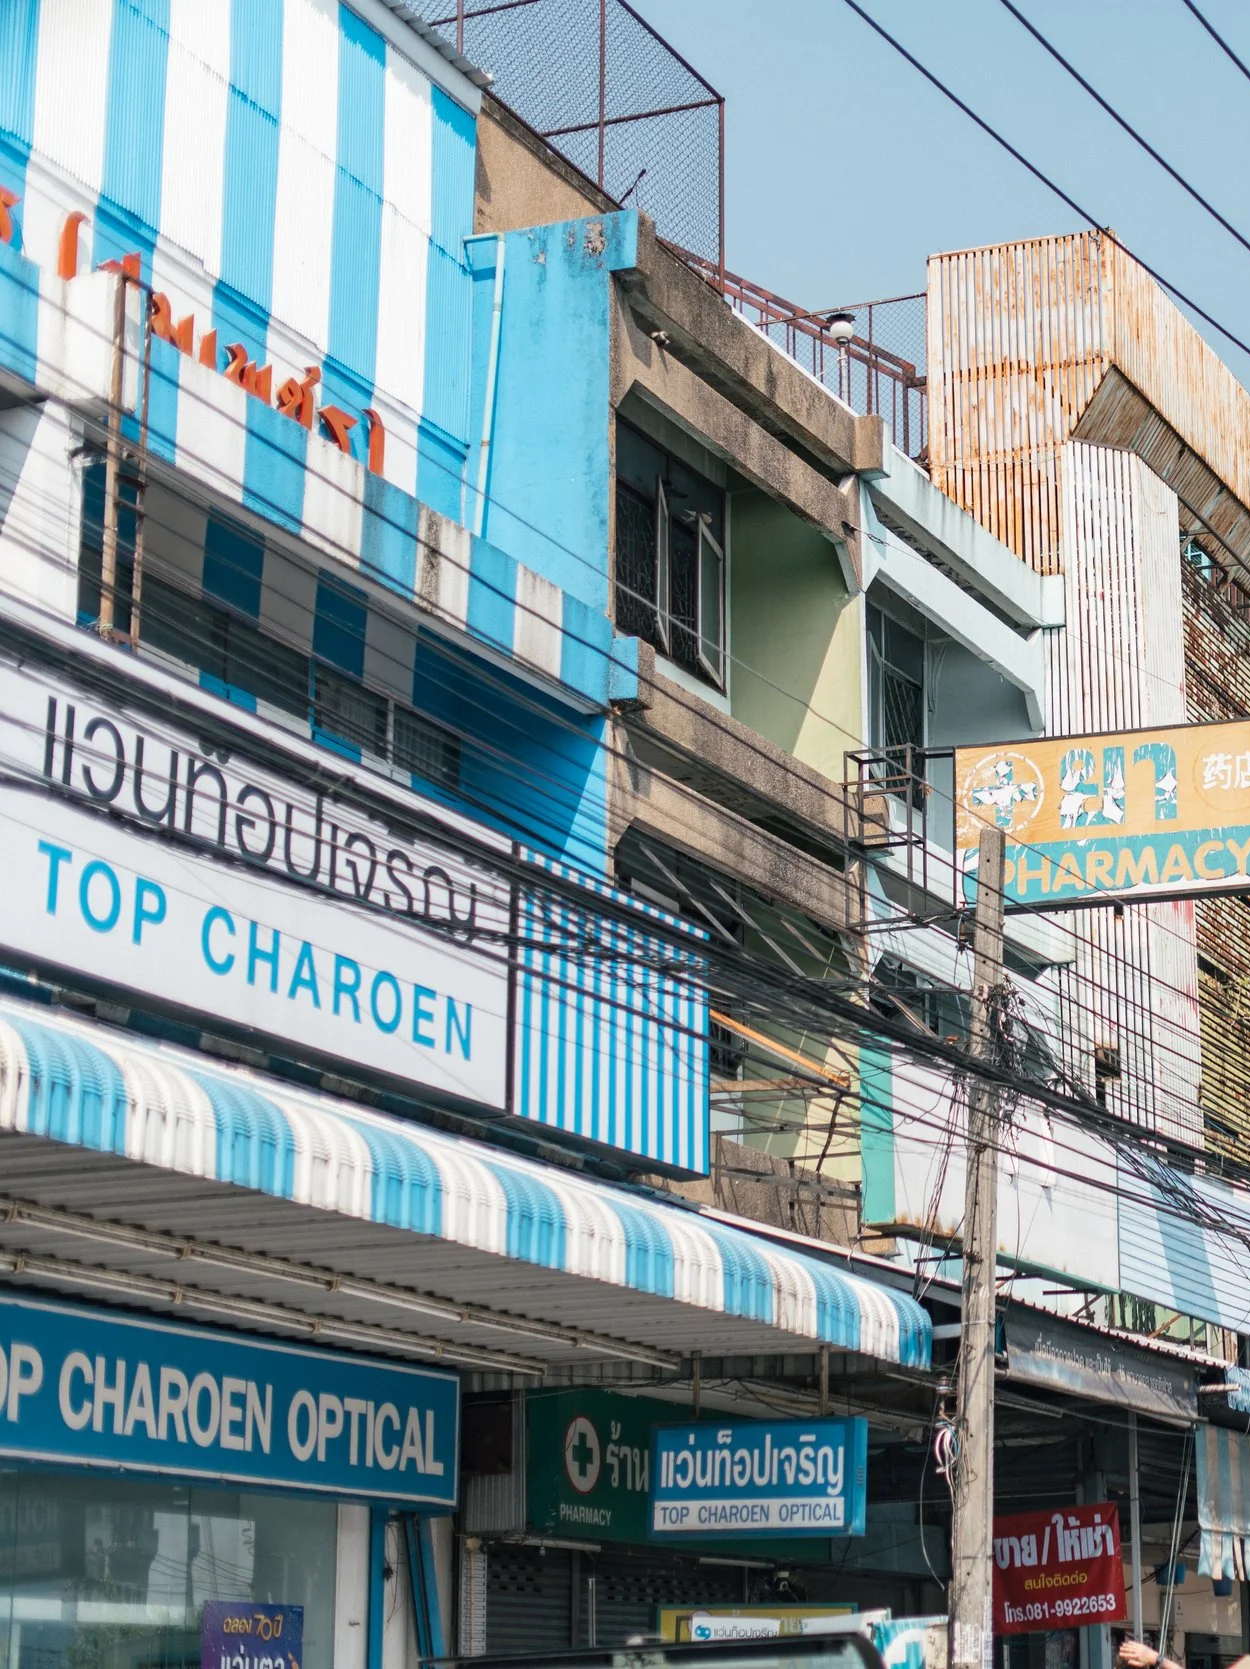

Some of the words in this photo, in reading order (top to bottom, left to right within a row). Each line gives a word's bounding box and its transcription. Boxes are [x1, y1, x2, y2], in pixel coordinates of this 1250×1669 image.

[1060, 742, 1178, 828] ยา
[37, 839, 168, 945] TOP
[201, 906, 472, 1062] CHAROEN
[0, 1343, 43, 1422] P
[59, 1351, 273, 1455] CHAROEN
[287, 1390, 444, 1477] OPTICAL
[606, 1420, 649, 1492] ร้าน
[660, 1430, 845, 1496] แว่นท็อปเจริญ
[560, 1503, 612, 1526] PHARMACY
[661, 1506, 690, 1526] TOP
[698, 1504, 771, 1525] CHAROEN
[778, 1502, 842, 1523] OPTICAL
[993, 1533, 1038, 1570] ขาย
[1051, 1513, 1115, 1563] ให้เช่า
[1024, 1571, 1088, 1590] สนใจติดต่อ
